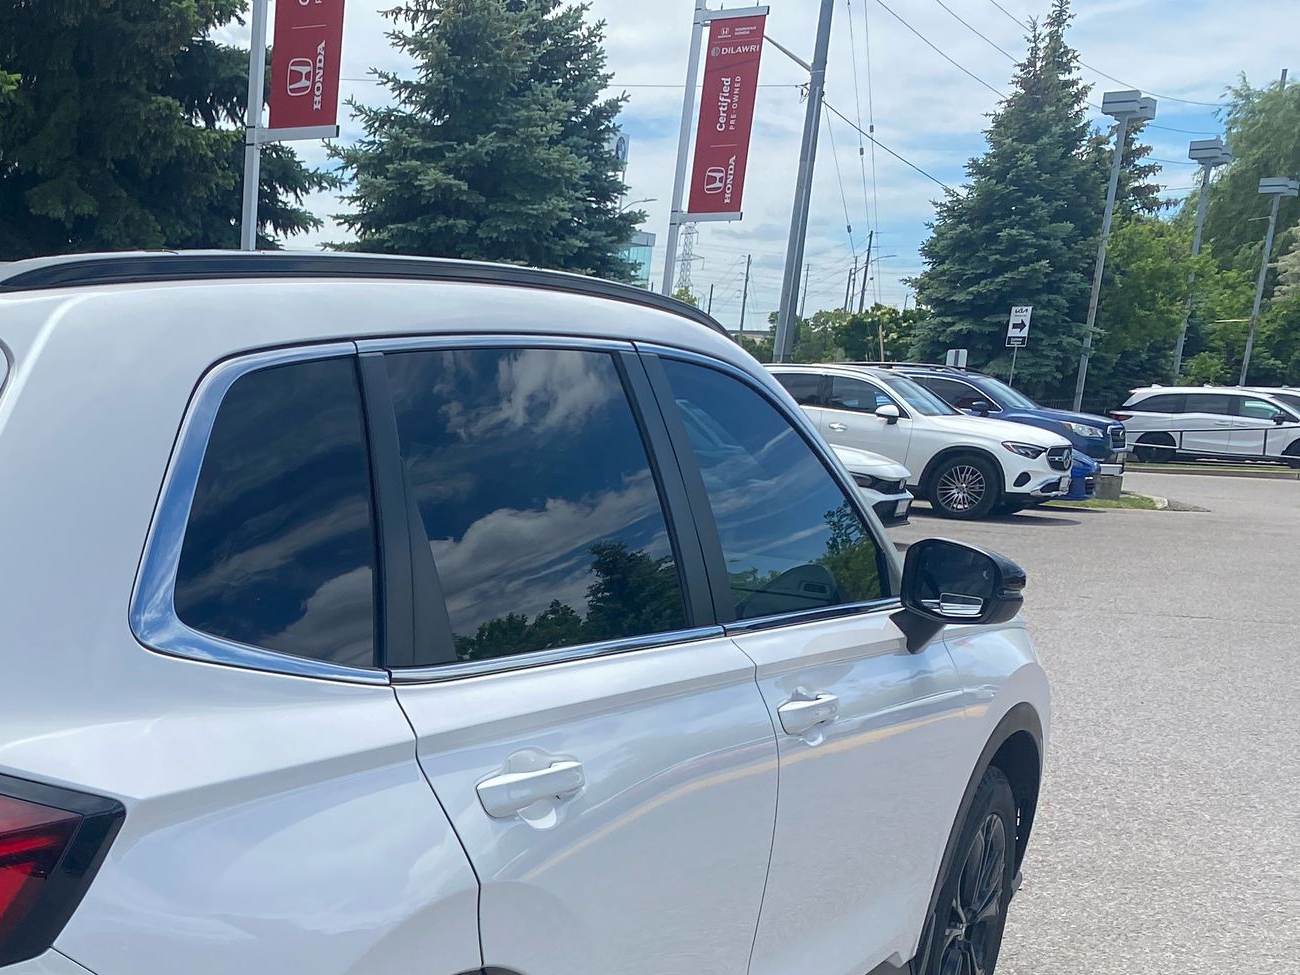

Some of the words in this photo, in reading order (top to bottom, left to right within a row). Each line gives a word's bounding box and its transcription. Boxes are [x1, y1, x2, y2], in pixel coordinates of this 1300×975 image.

[313, 40, 326, 111] HONDA
[721, 44, 760, 55] DILAWRI
[716, 77, 732, 132] Certified
[729, 75, 742, 131] PRE-OWNED
[724, 155, 736, 204] HONDA
